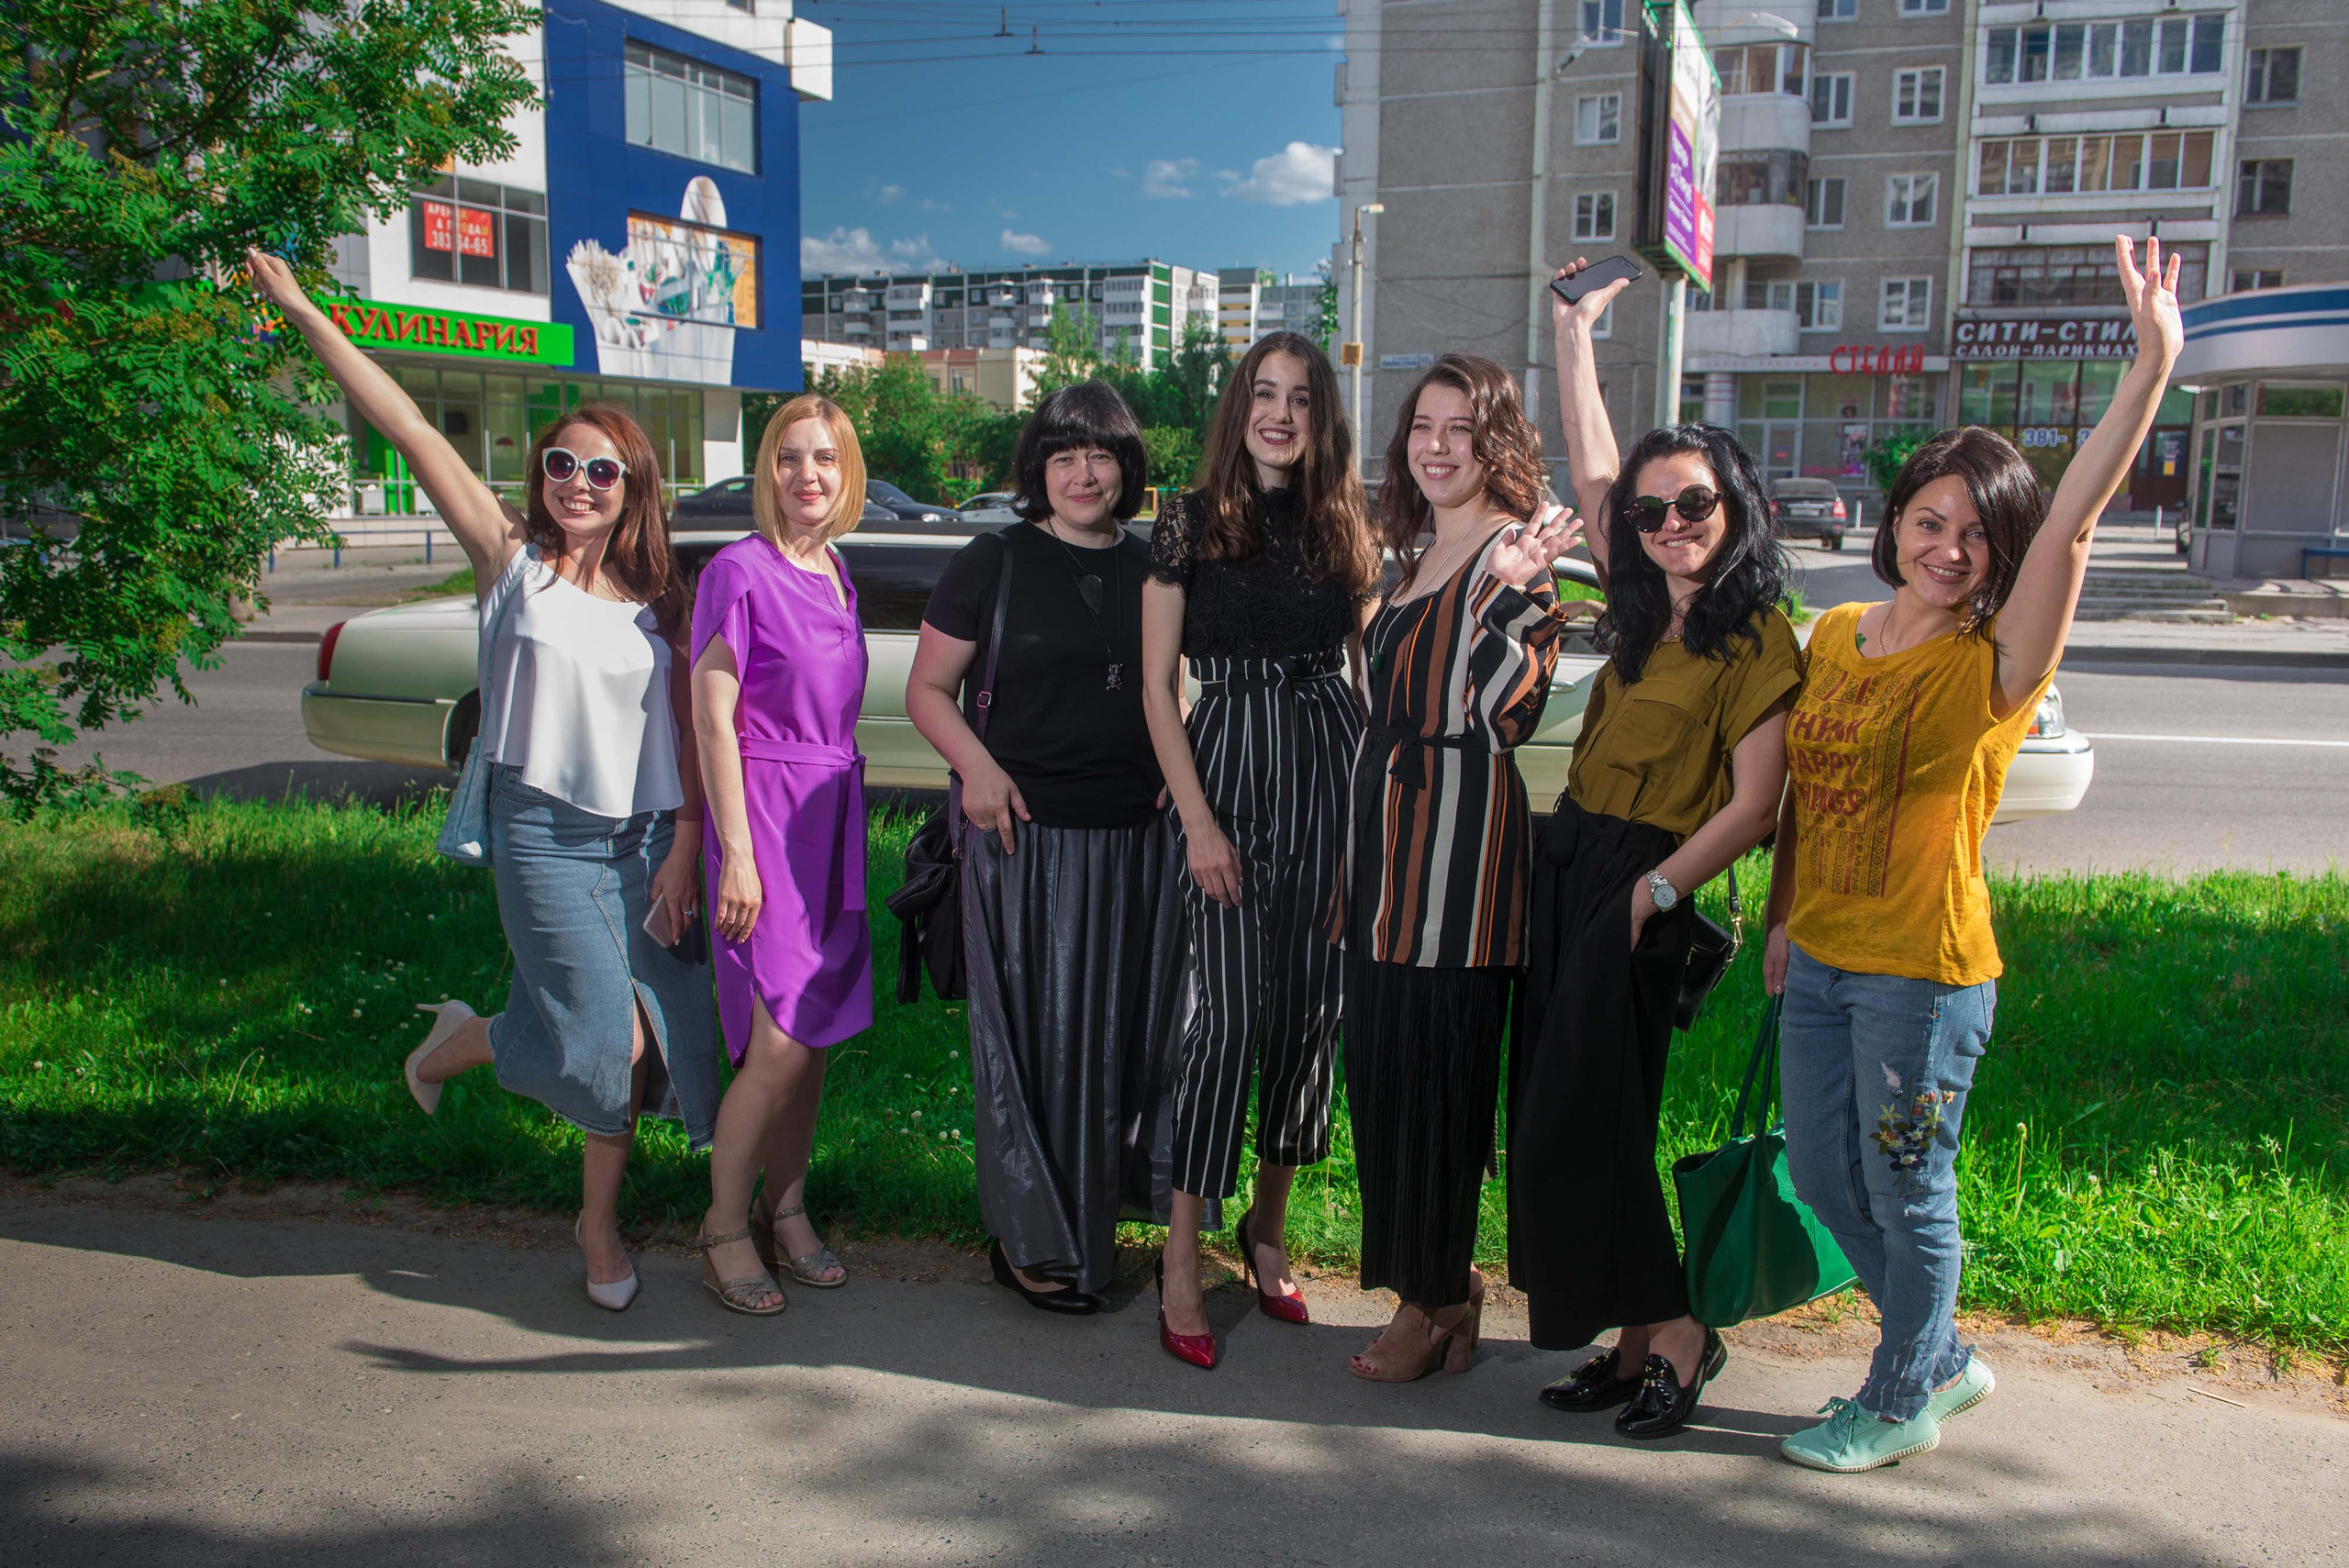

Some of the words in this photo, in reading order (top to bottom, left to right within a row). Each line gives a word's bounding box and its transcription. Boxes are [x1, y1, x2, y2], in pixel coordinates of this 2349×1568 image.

[328, 303, 540, 355] КУЛИНАРИЯ
[1830, 343, 1925, 376] СТЕЛЛА
[1787, 708, 1868, 744] THINK
